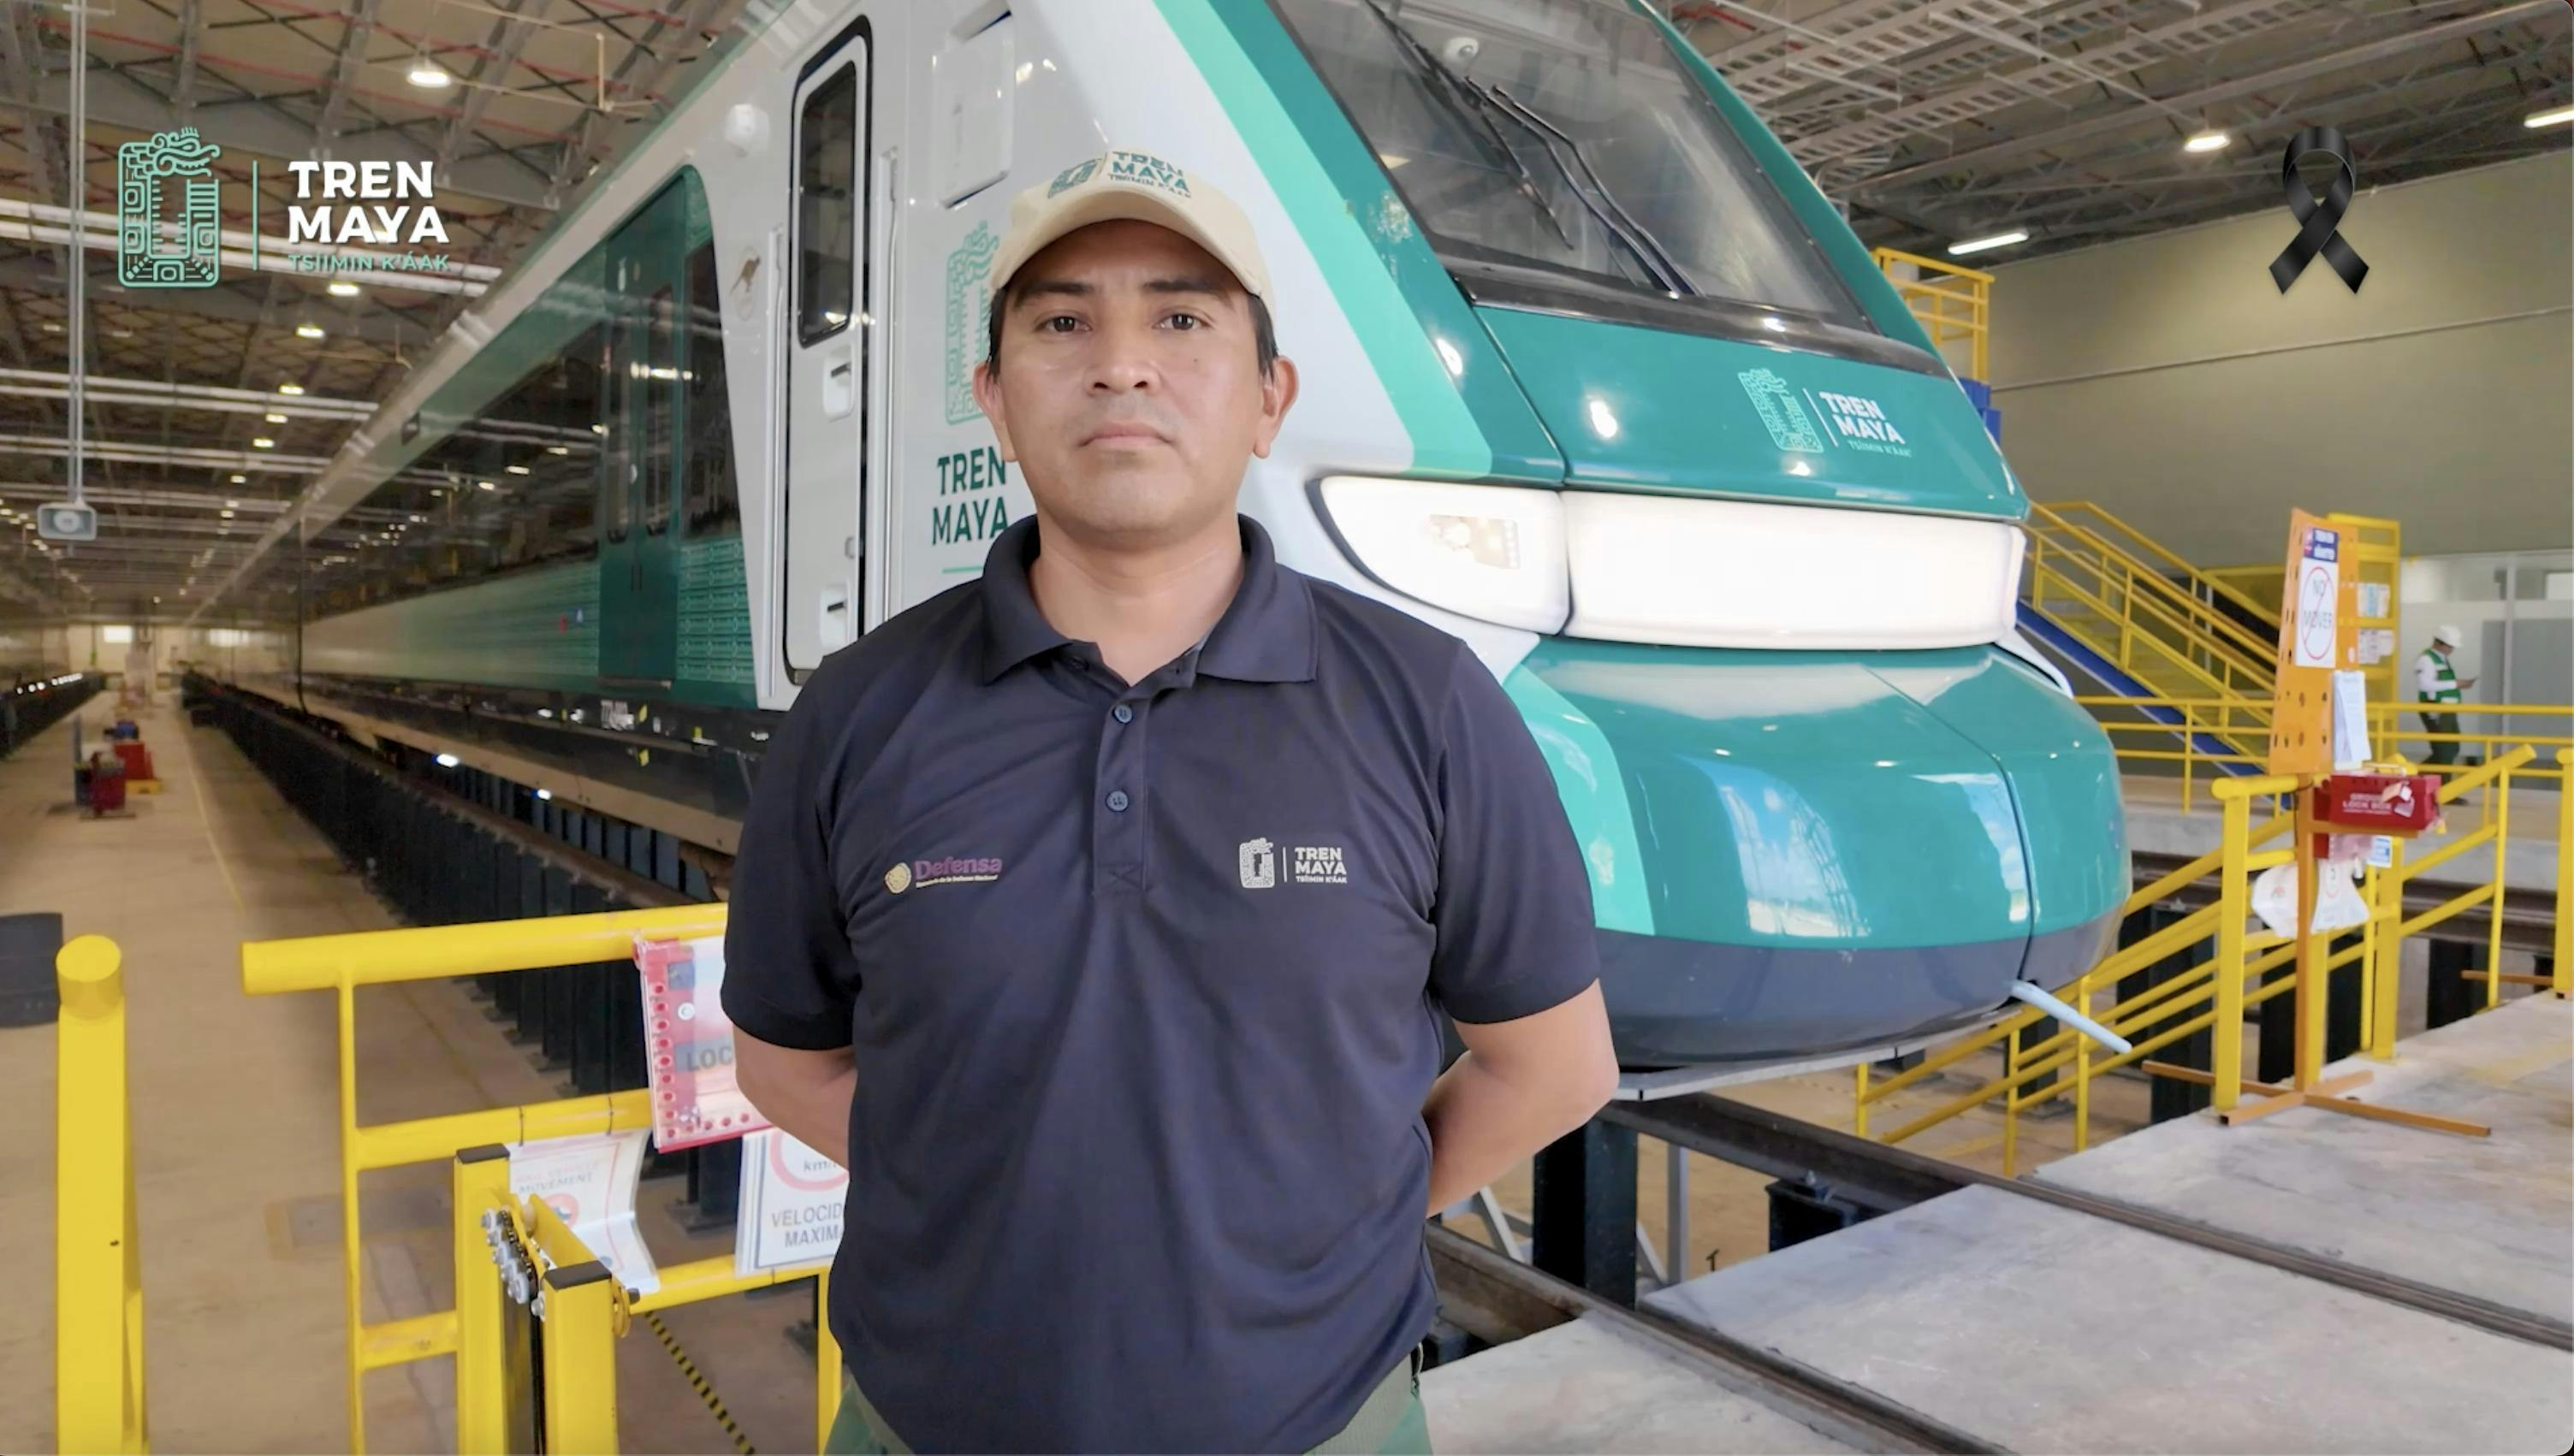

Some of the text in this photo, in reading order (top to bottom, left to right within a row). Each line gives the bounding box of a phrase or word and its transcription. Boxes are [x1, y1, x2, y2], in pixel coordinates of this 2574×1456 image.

[1112, 162, 1191, 193] MAYA
[1818, 391, 1886, 421] TREN
[1831, 413, 1906, 445] MAYA
[936, 446, 1006, 495] TREN
[932, 496, 1009, 546] MAYA
[1294, 847, 1342, 861] TREN
[915, 856, 1003, 880] Defensa
[1295, 861, 1348, 874] MAYA
[686, 1045, 734, 1072] LOC
[518, 1171, 594, 1193] MOVEMENT
[771, 1202, 844, 1228] VELOCID
[785, 1224, 843, 1248] MAXIM
